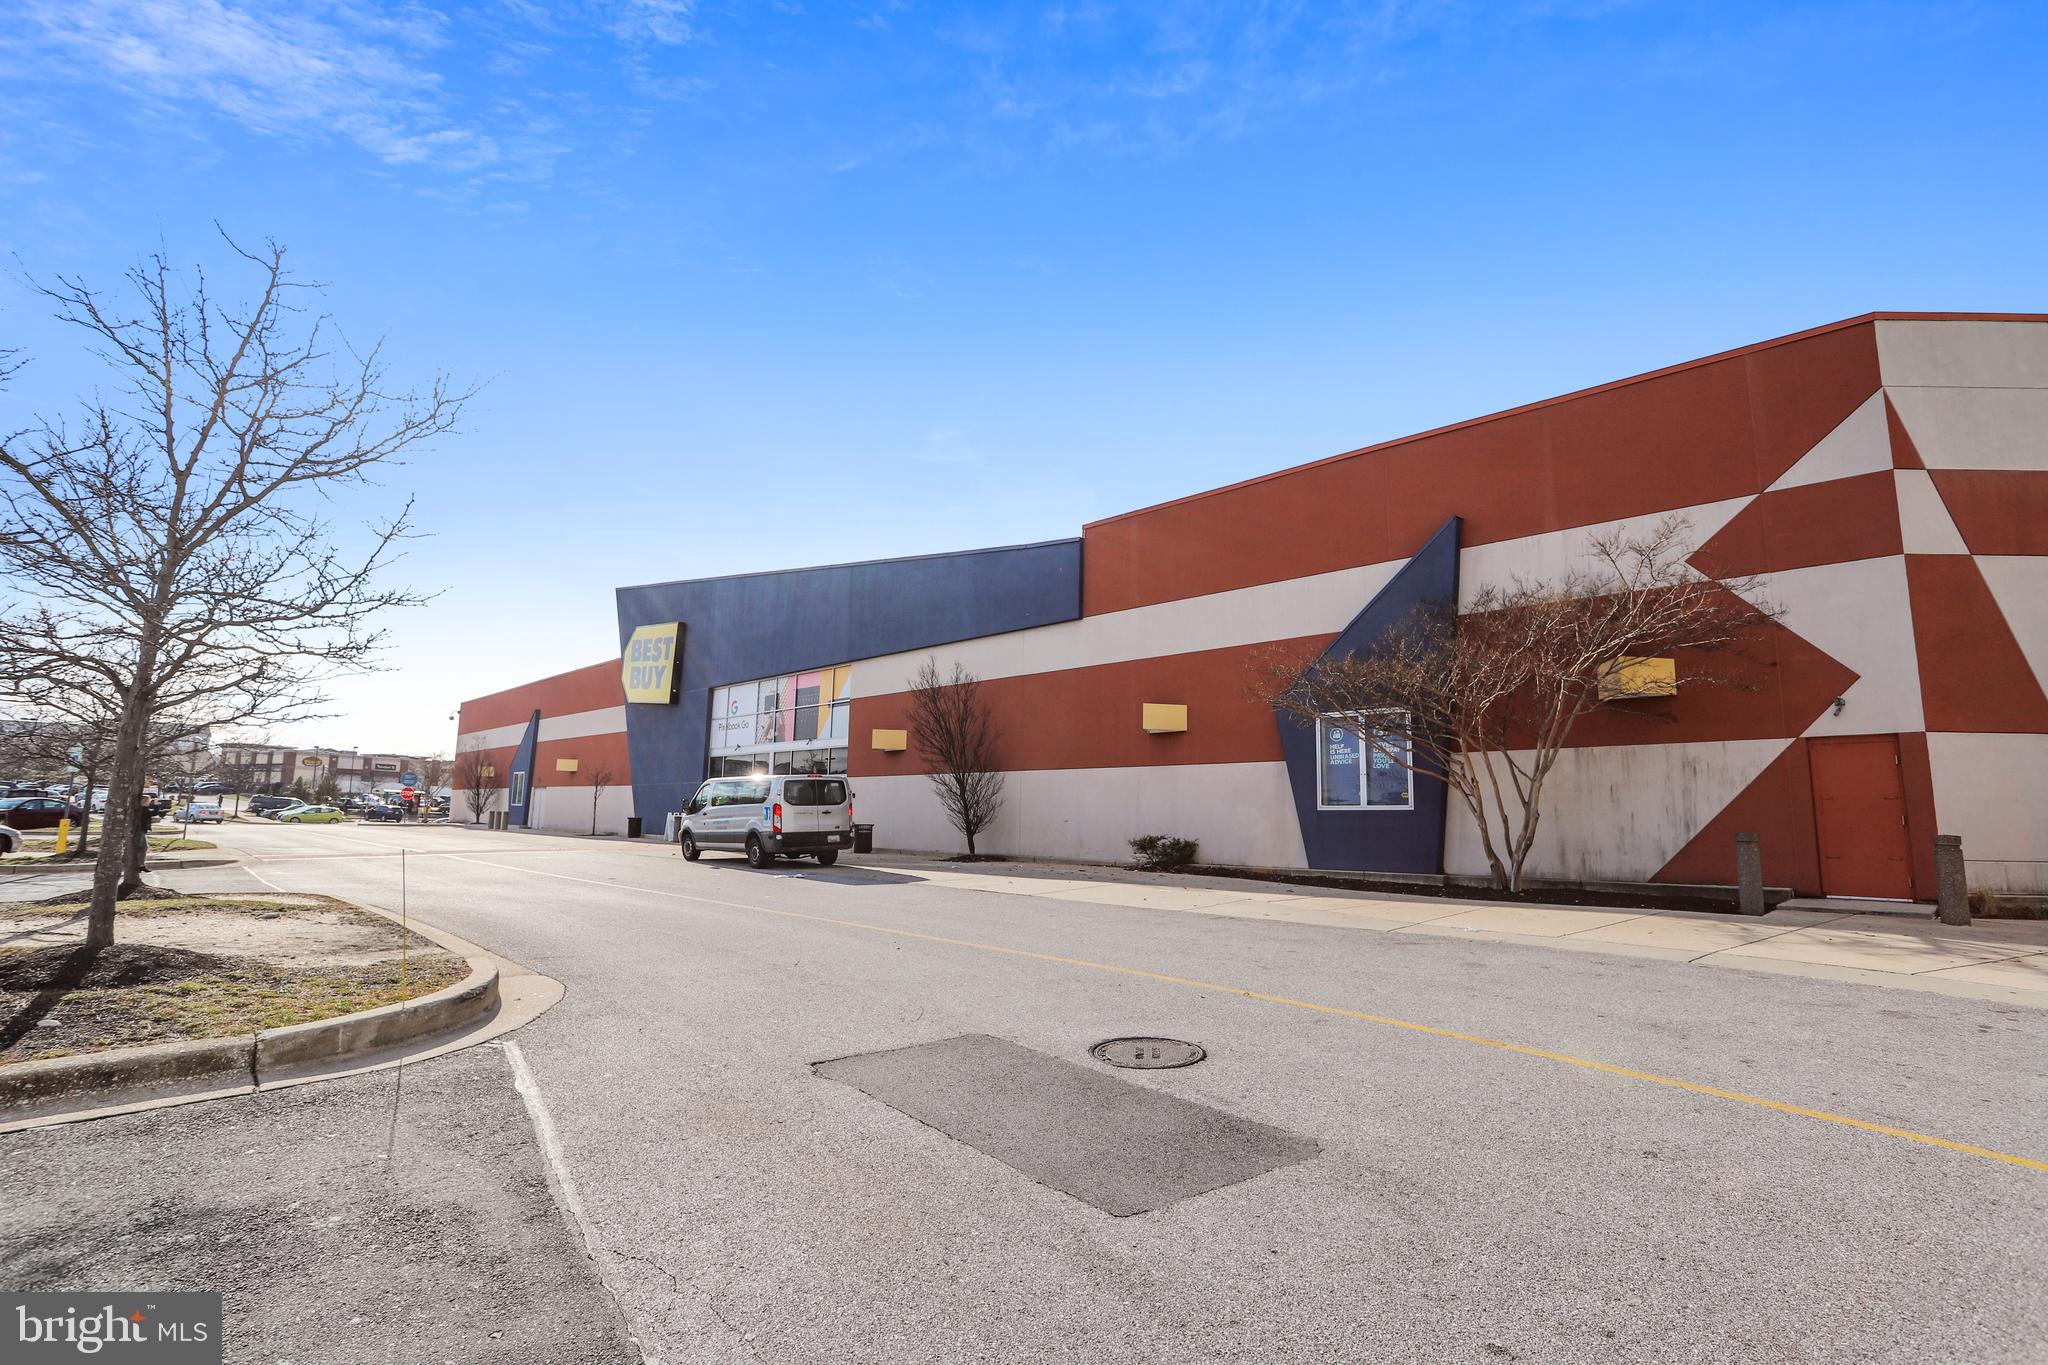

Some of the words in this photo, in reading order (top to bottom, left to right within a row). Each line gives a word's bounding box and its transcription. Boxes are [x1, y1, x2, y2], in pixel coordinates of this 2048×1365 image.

[631, 636, 674, 662] BEST
[630, 665, 668, 689] BUY
[741, 720, 749, 729] Go
